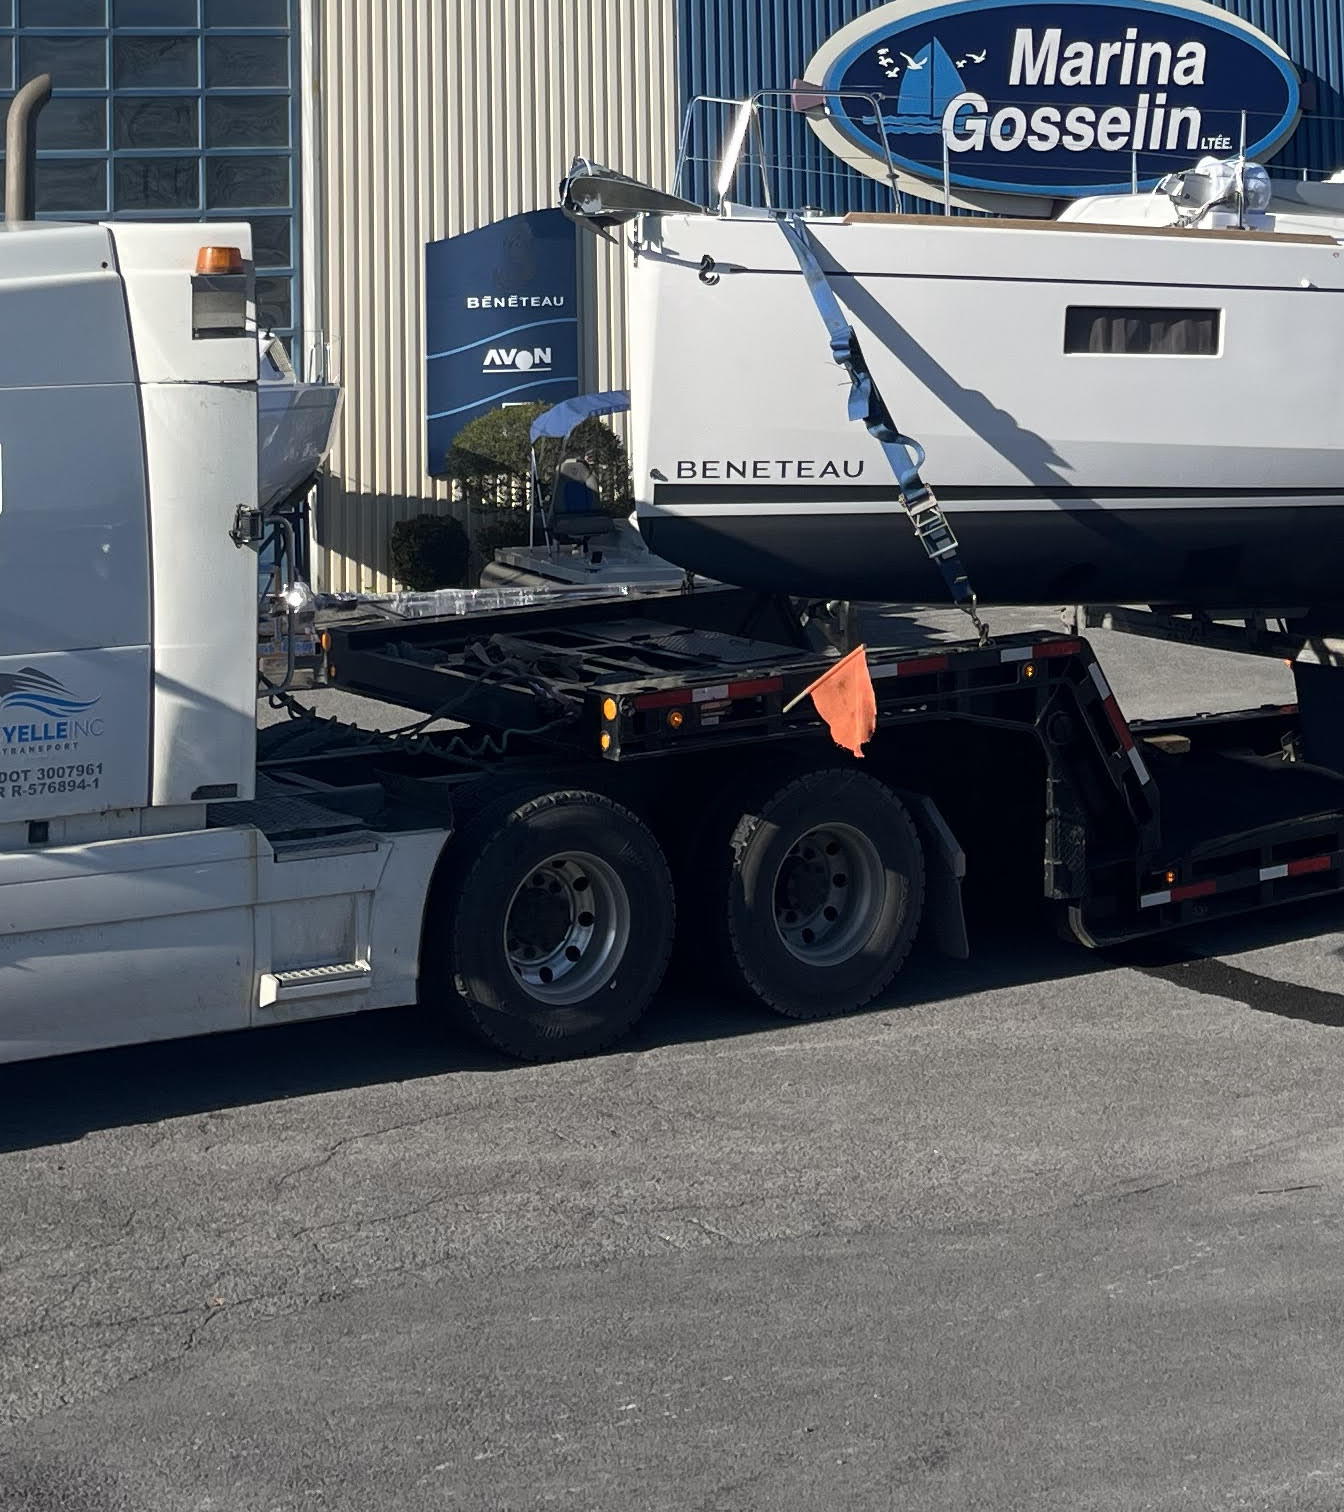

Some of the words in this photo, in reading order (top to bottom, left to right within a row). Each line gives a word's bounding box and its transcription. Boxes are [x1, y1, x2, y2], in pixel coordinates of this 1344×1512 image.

[1008, 27, 1207, 87] Marina
[941, 91, 1202, 153] Gosselin
[483, 347, 552, 370] AVON
[676, 460, 865, 479] BENETEAU
[2, 742, 78, 755] TRANSPORT
[36, 762, 103, 781] 3007961
[11, 777, 100, 798] R-576894-1
